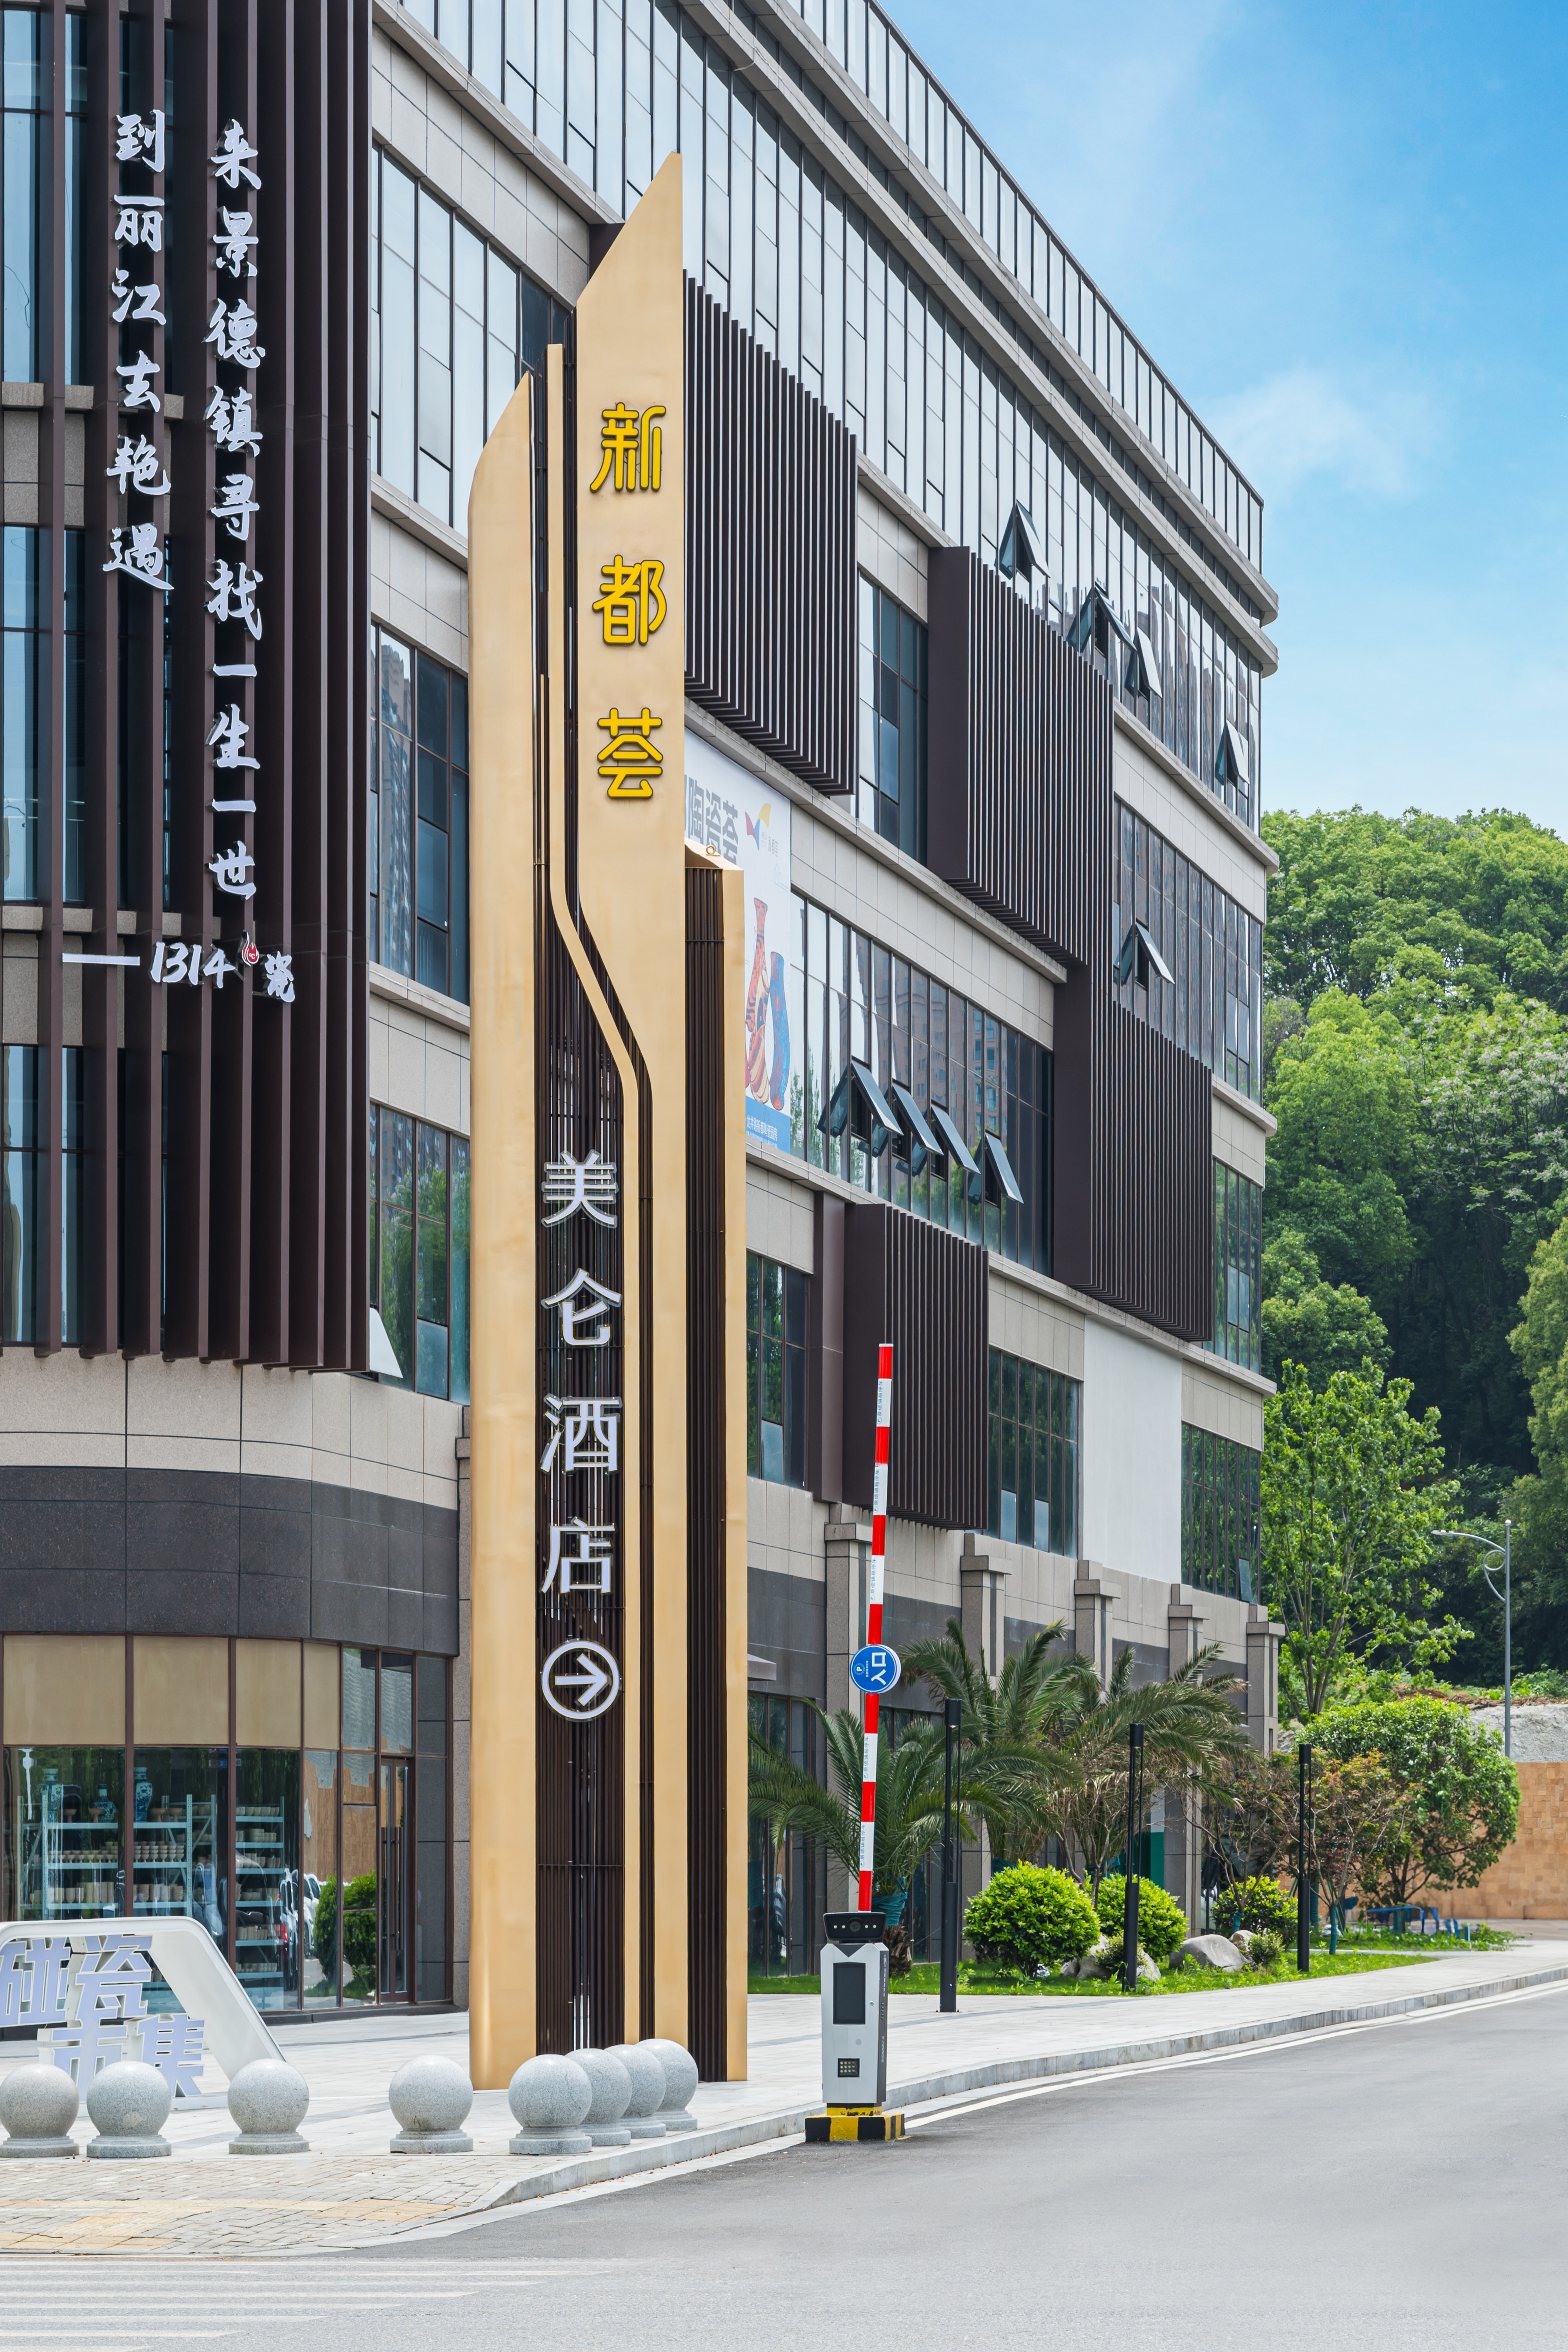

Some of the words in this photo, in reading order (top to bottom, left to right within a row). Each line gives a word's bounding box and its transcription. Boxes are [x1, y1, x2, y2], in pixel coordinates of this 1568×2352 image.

[103, 109, 174, 590] 到丽江去艳遇
[205, 119, 266, 900] 来景德镇寻找一生一世
[590, 403, 666, 799] 新都荟
[684, 774, 738, 865] 陶瓷荟
[540, 1149, 622, 1594] 美仑酒店
[871, 1652, 886, 1685] 入口
